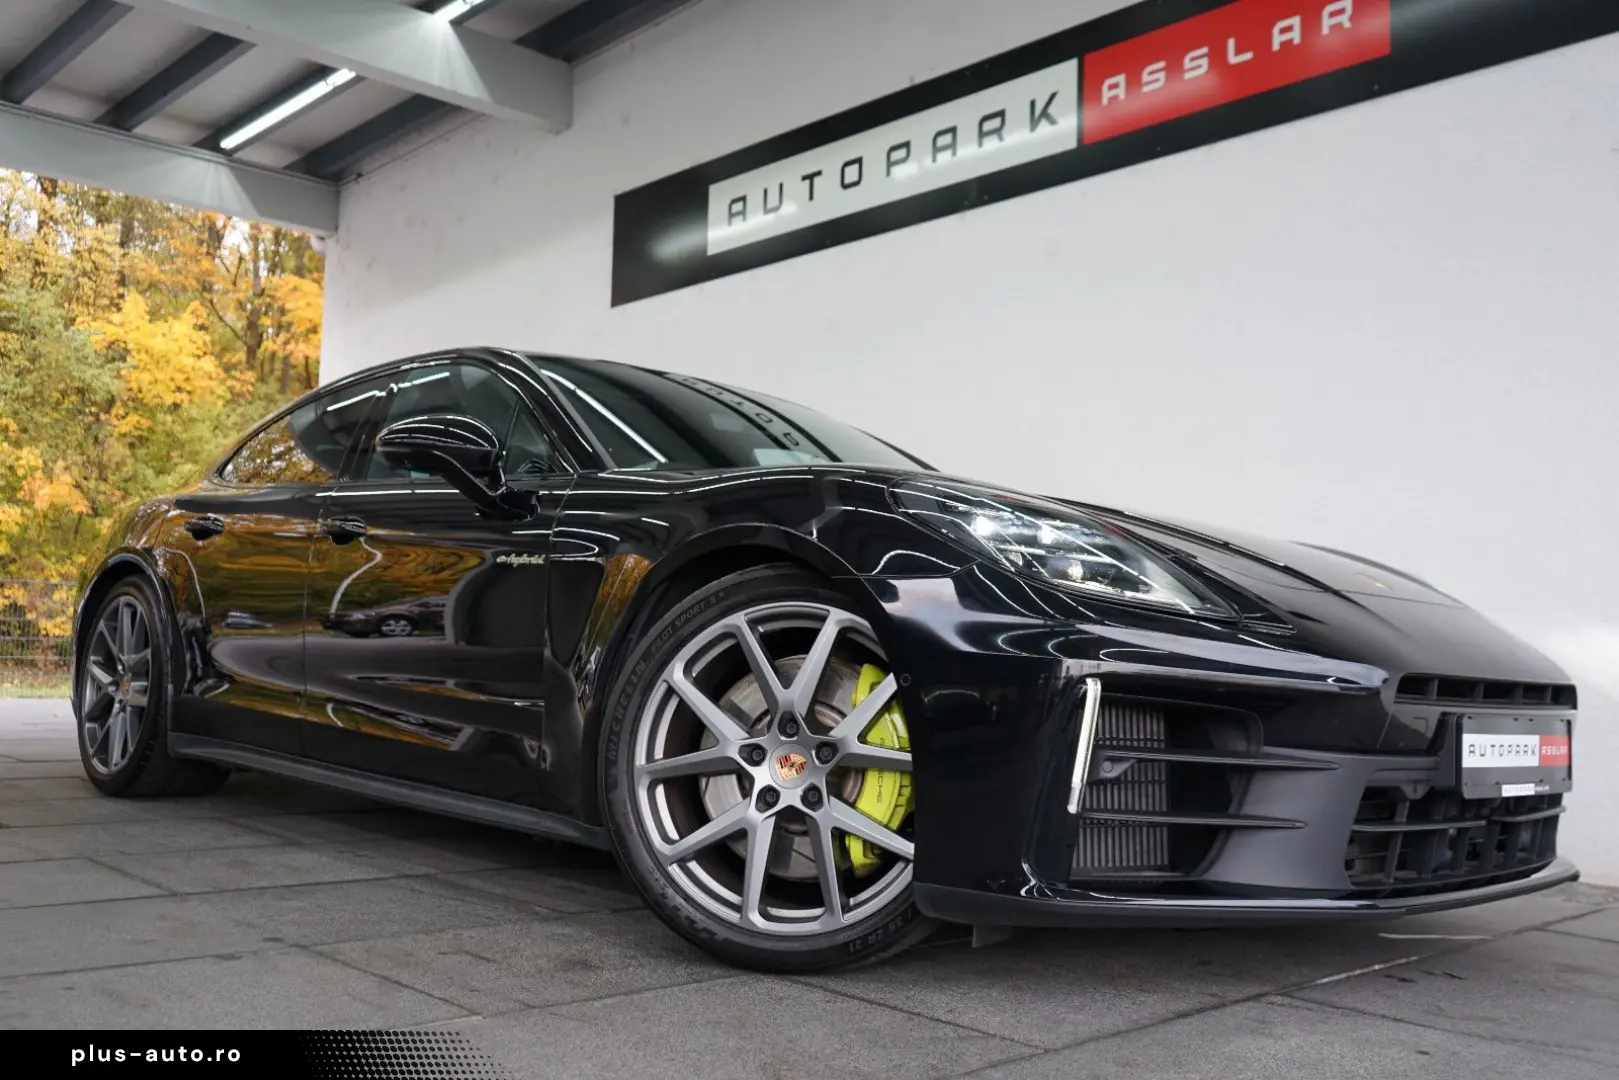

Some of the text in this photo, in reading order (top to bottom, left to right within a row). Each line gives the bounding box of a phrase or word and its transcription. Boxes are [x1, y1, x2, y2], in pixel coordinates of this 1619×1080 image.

[728, 0, 1353, 227] AUTOPARK ASSLAR
[607, 661, 646, 760] MICHELIN
[1468, 744, 1537, 757] AUTOPARK
[877, 737, 885, 804] PCHE
